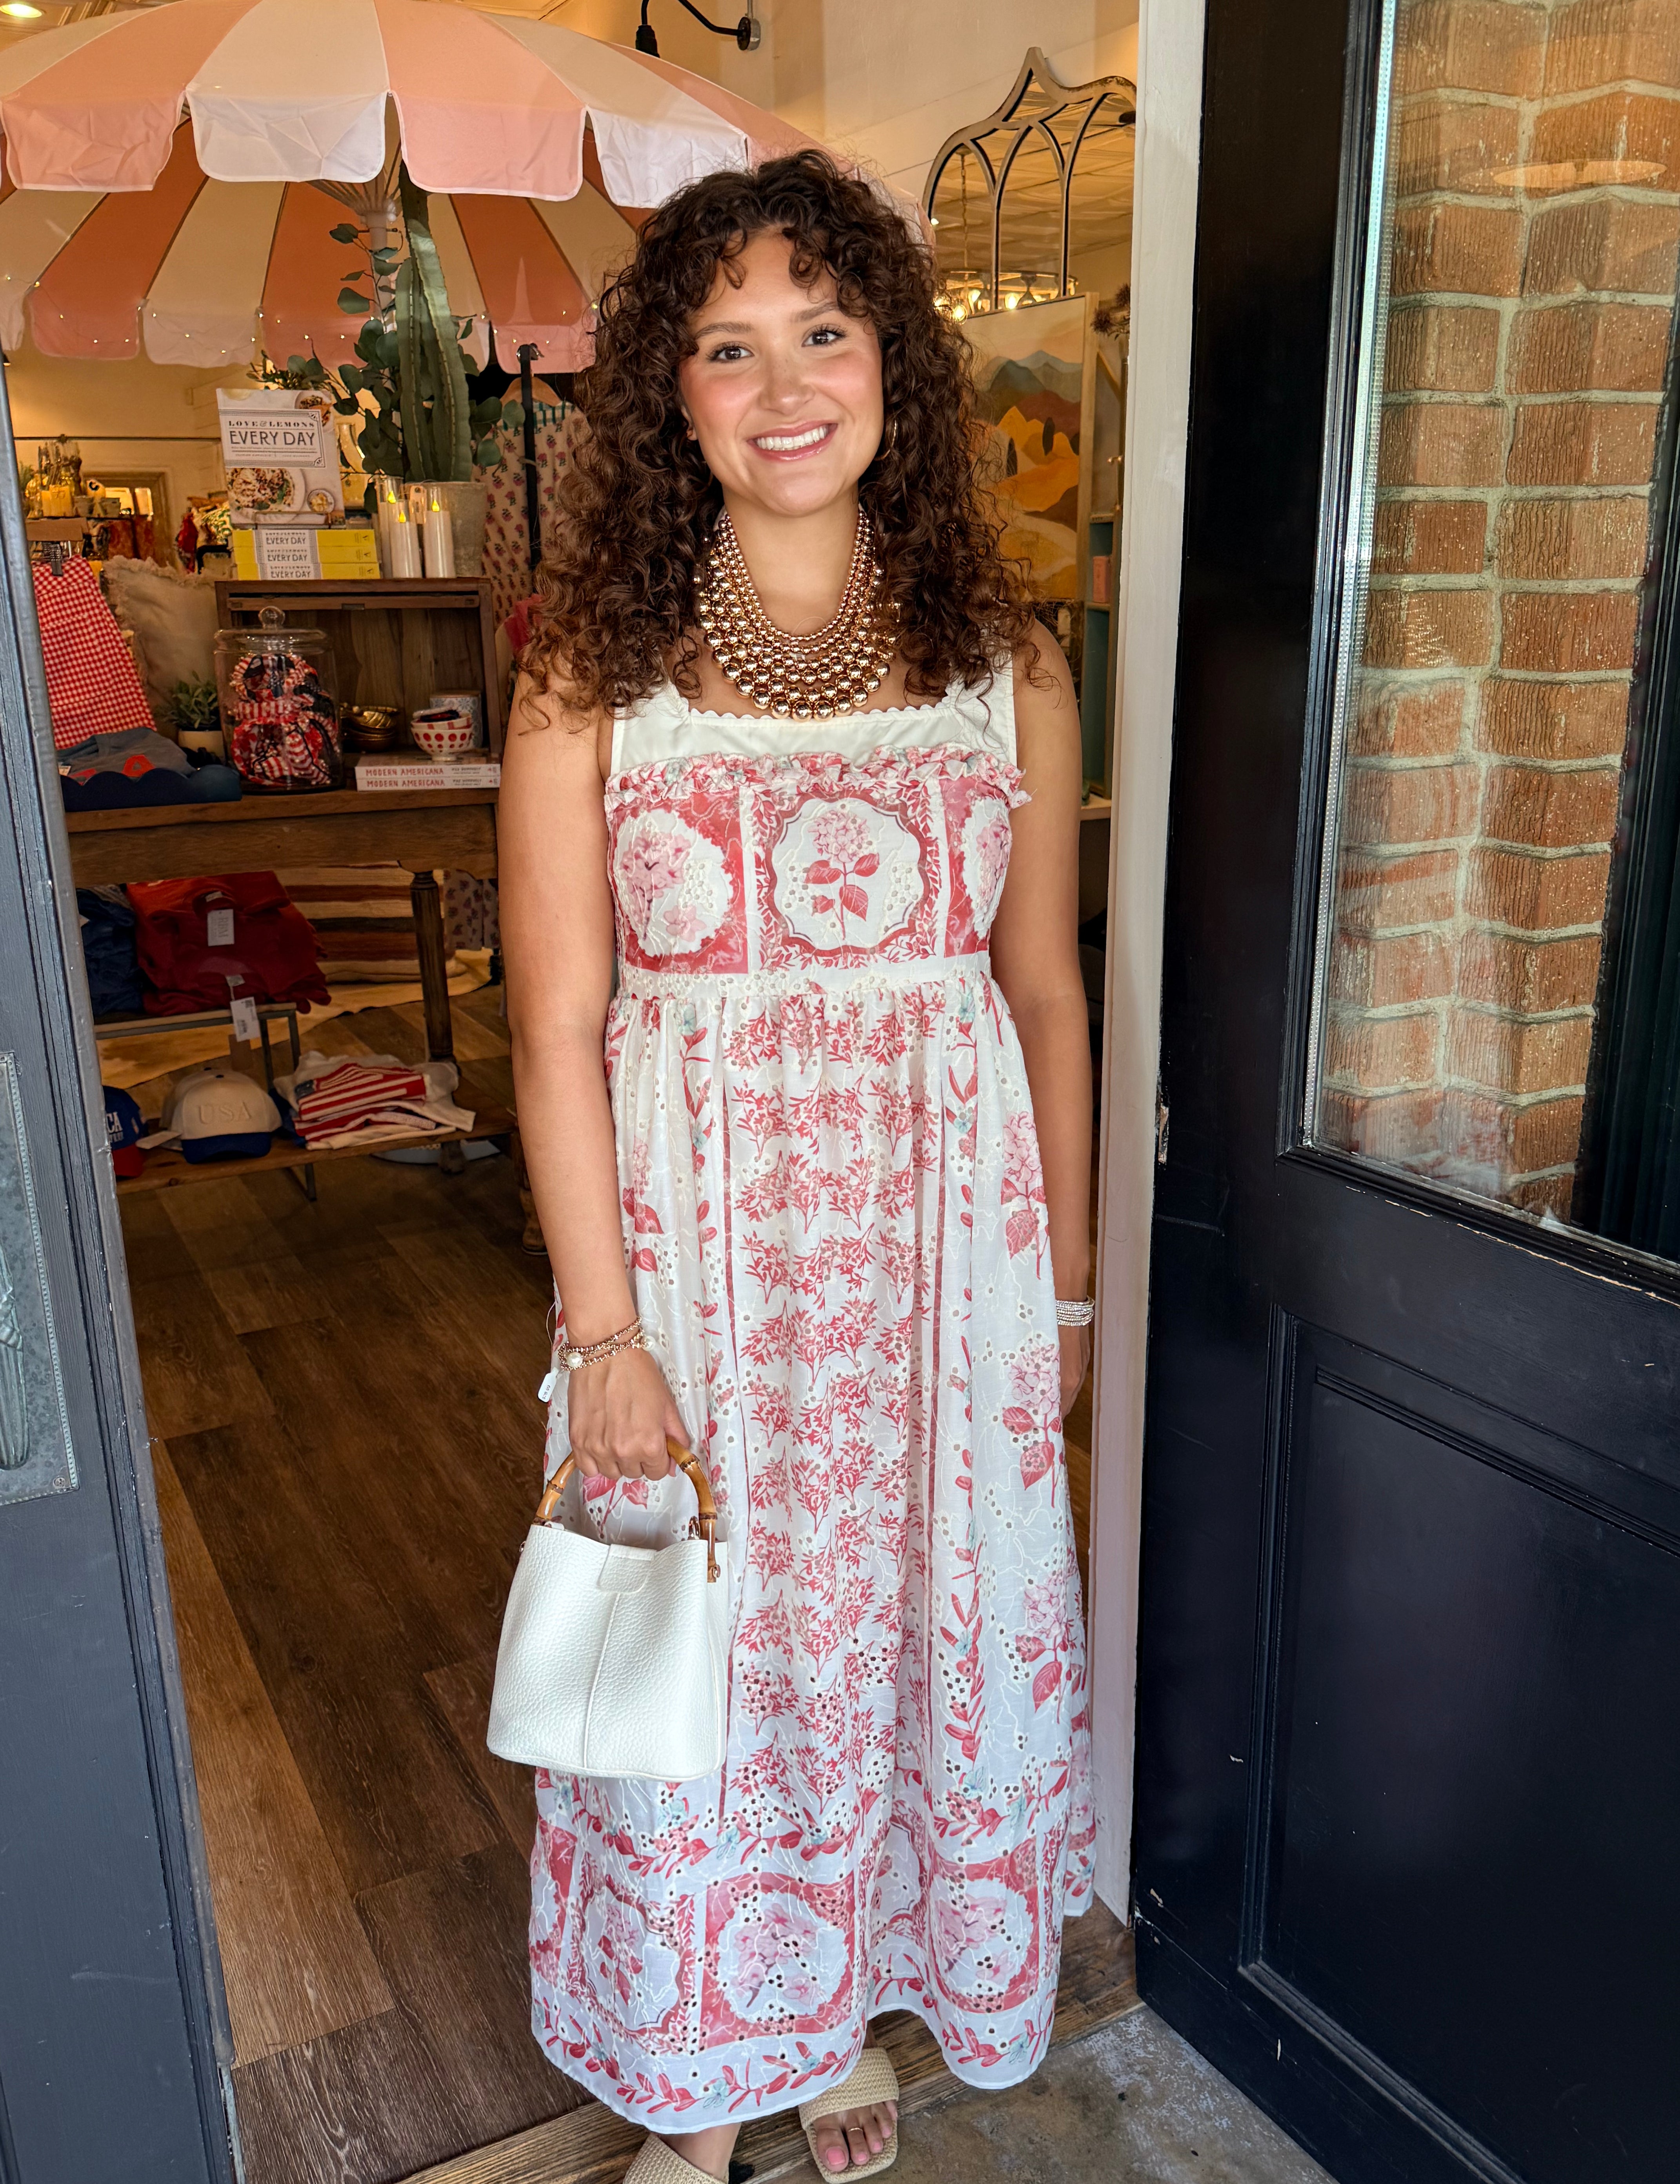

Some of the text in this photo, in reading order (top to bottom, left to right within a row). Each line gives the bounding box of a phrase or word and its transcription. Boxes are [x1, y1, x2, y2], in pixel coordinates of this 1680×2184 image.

[229, 431, 315, 445] EVERY DAY
[401, 767, 444, 776] AMERICANA
[197, 1101, 252, 1125] USA
